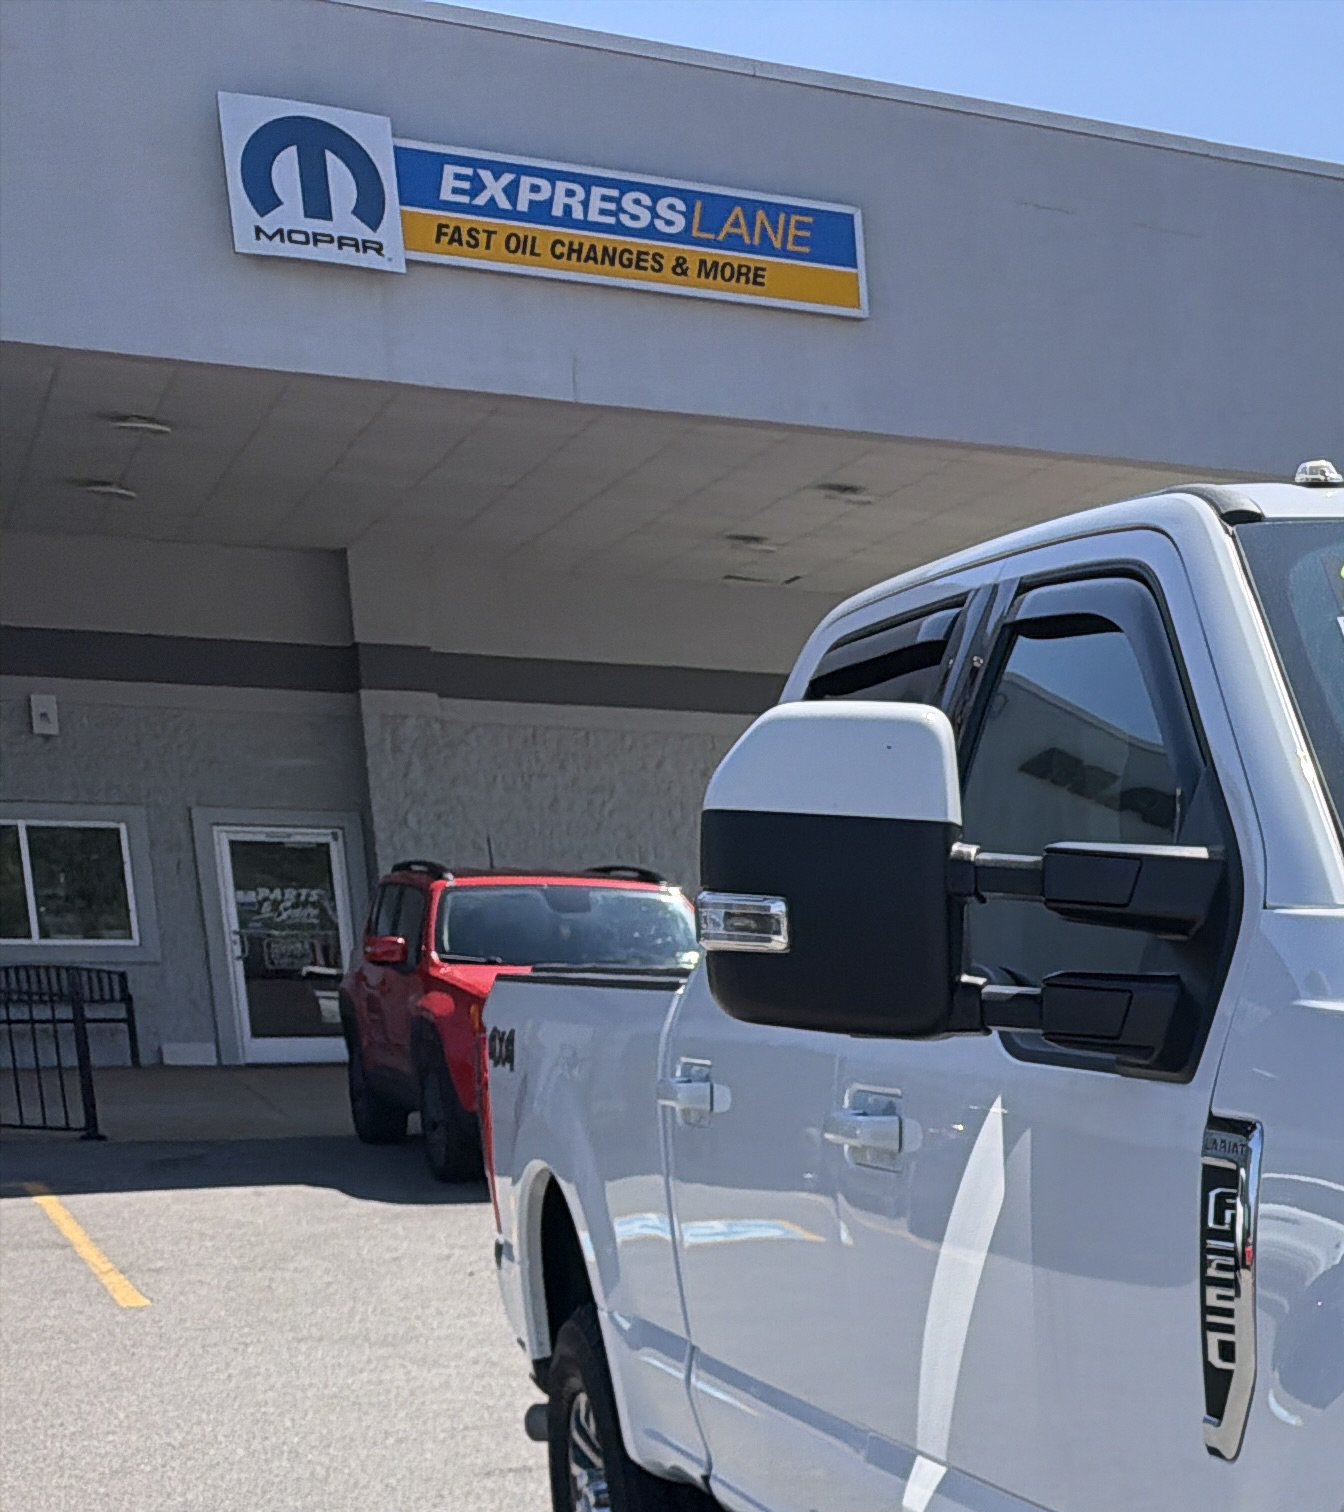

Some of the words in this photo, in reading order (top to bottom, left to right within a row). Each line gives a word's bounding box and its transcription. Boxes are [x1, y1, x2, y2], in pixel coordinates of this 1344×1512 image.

[253, 225, 386, 257] MOPAR
[433, 223, 497, 251] FAST
[503, 231, 542, 258] OIL
[549, 237, 665, 274] CHANGES
[671, 255, 690, 279] &
[696, 258, 767, 287] MORE
[257, 887, 323, 902] PARTS
